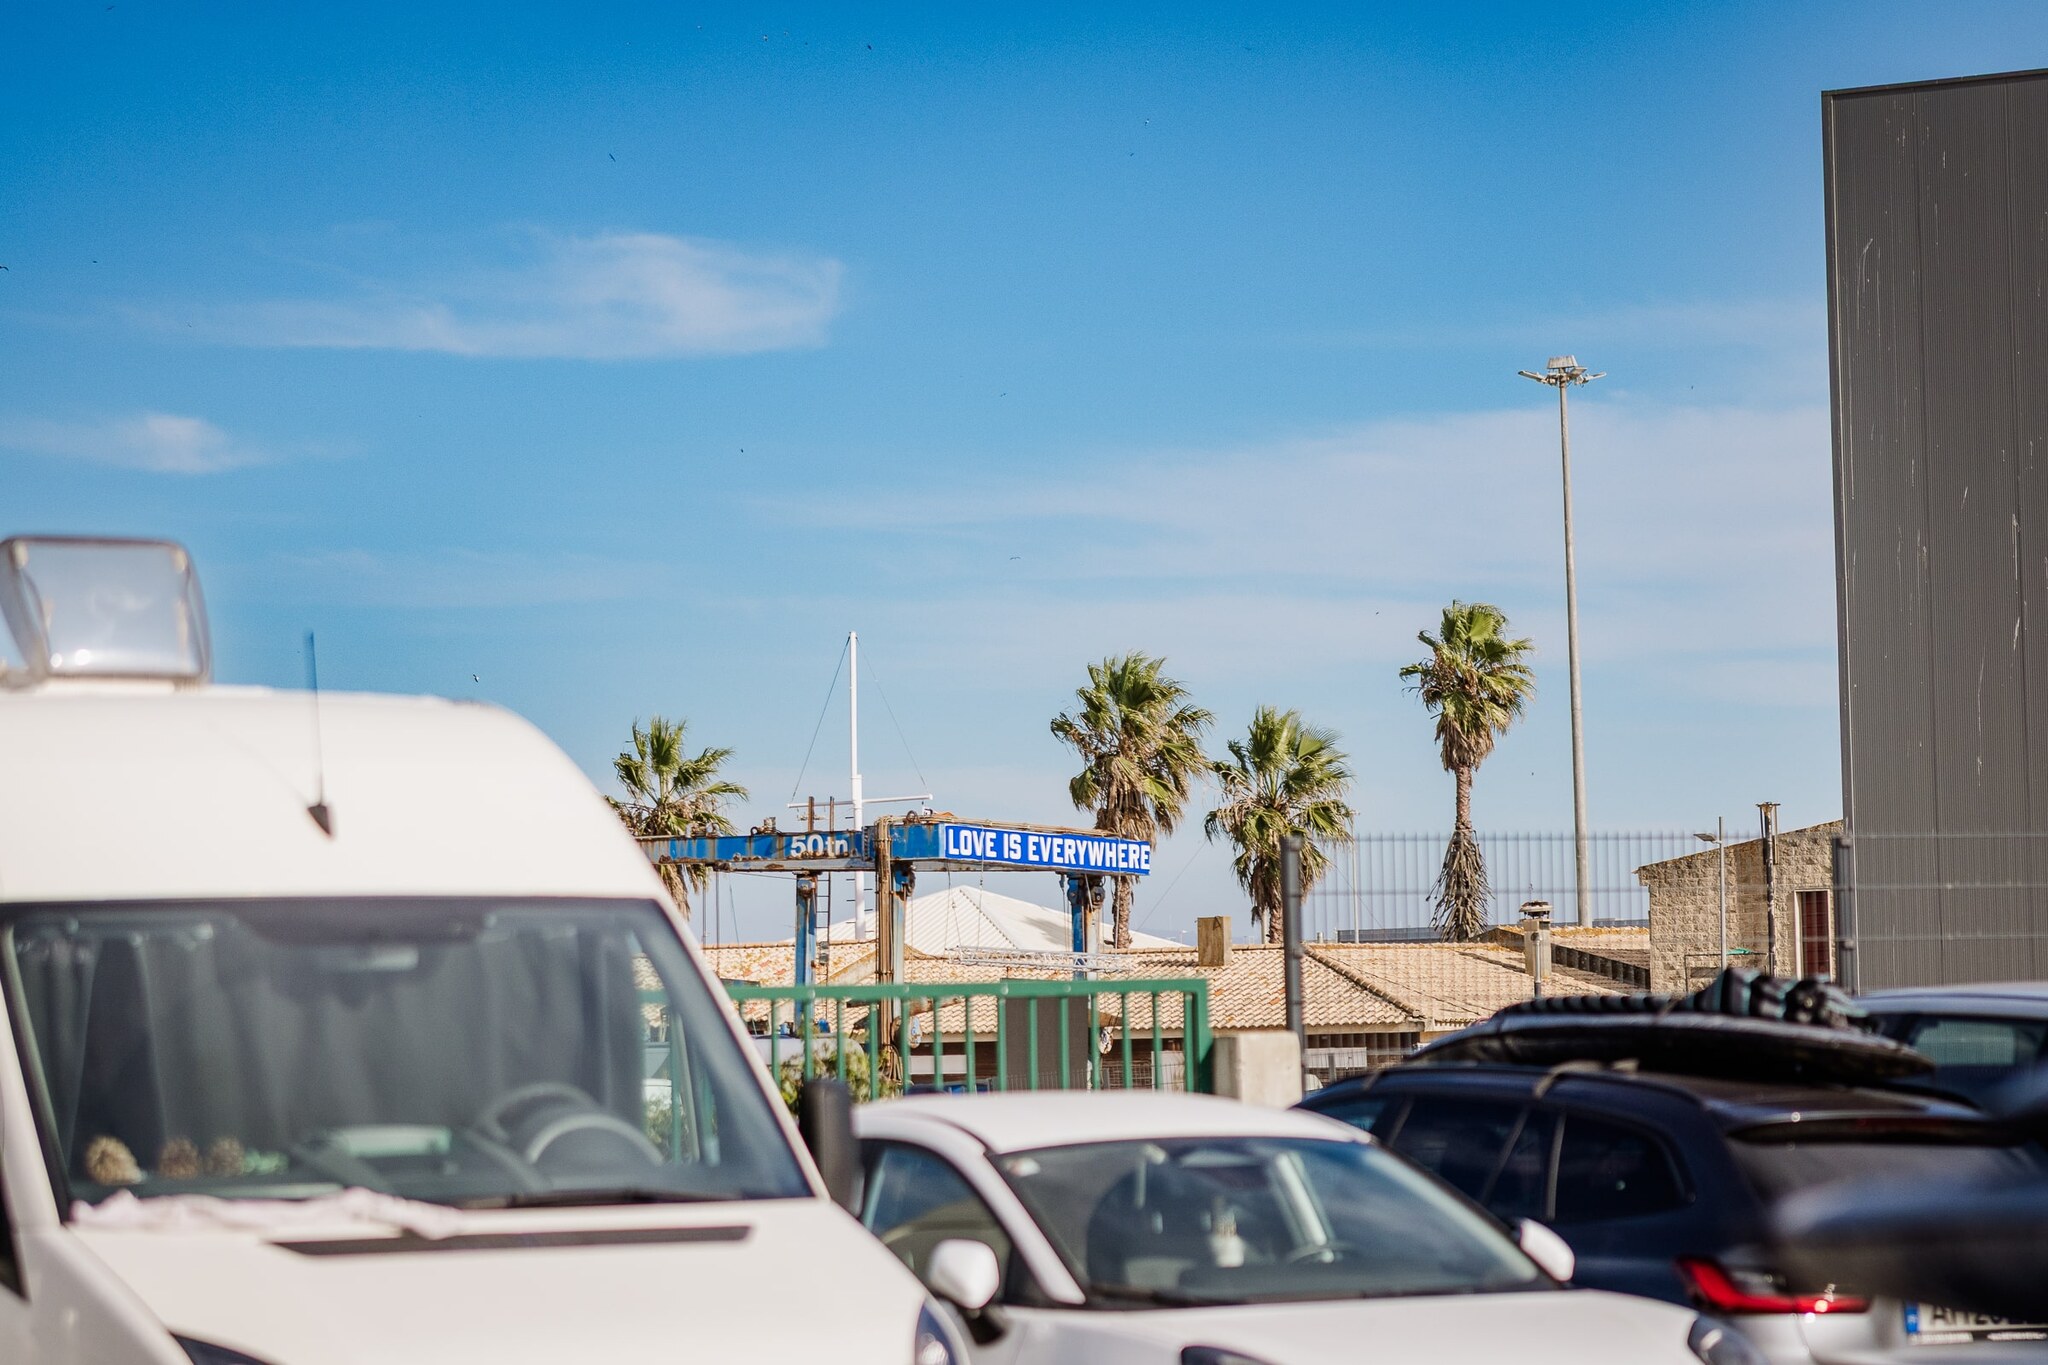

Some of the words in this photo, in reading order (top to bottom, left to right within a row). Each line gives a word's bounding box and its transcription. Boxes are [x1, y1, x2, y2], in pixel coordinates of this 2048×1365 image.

[947, 828, 997, 858] LOVE
[1003, 833, 1022, 860] IS
[1027, 835, 1150, 870] EVERYWHERE
